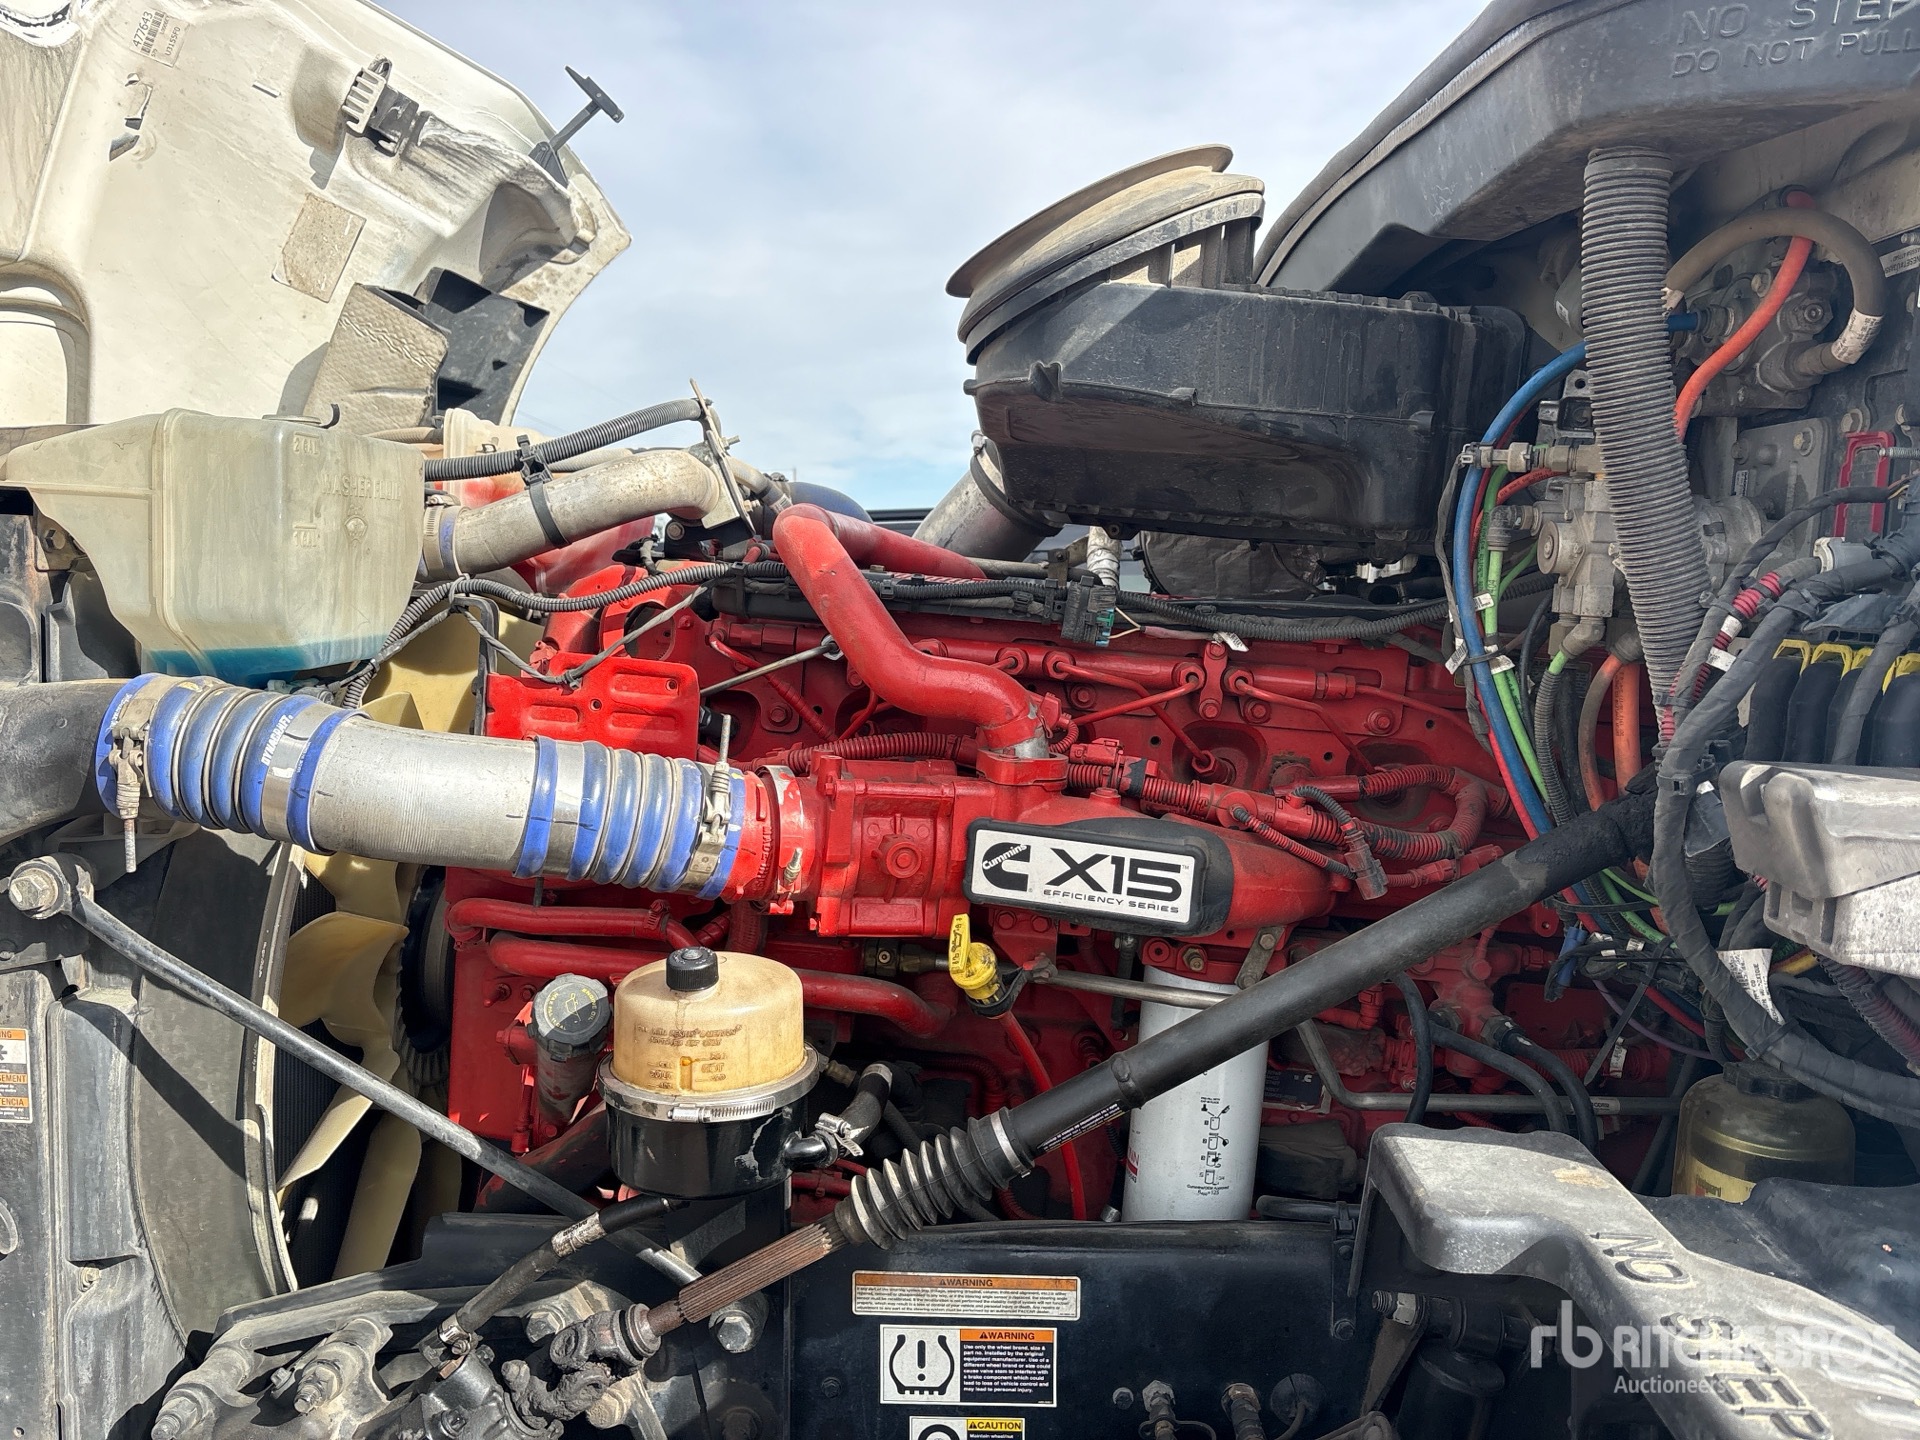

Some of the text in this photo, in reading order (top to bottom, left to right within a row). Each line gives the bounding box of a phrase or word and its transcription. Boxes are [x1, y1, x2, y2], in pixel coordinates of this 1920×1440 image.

[132, 11, 153, 47] 477643
[1677, 4, 1750, 45] NO
[1671, 50, 1720, 78] DO
[1744, 37, 1815, 67] NOT
[982, 844, 1027, 870] Cummins
[1045, 848, 1182, 902] X15
[1043, 889, 1179, 914] EFFICIENCY SERIES
[1589, 1231, 1690, 1284] NO
[946, 1278, 993, 1286] WARNING
[988, 1332, 1035, 1340] WARNING
[977, 1421, 1022, 1430] CAUTION
